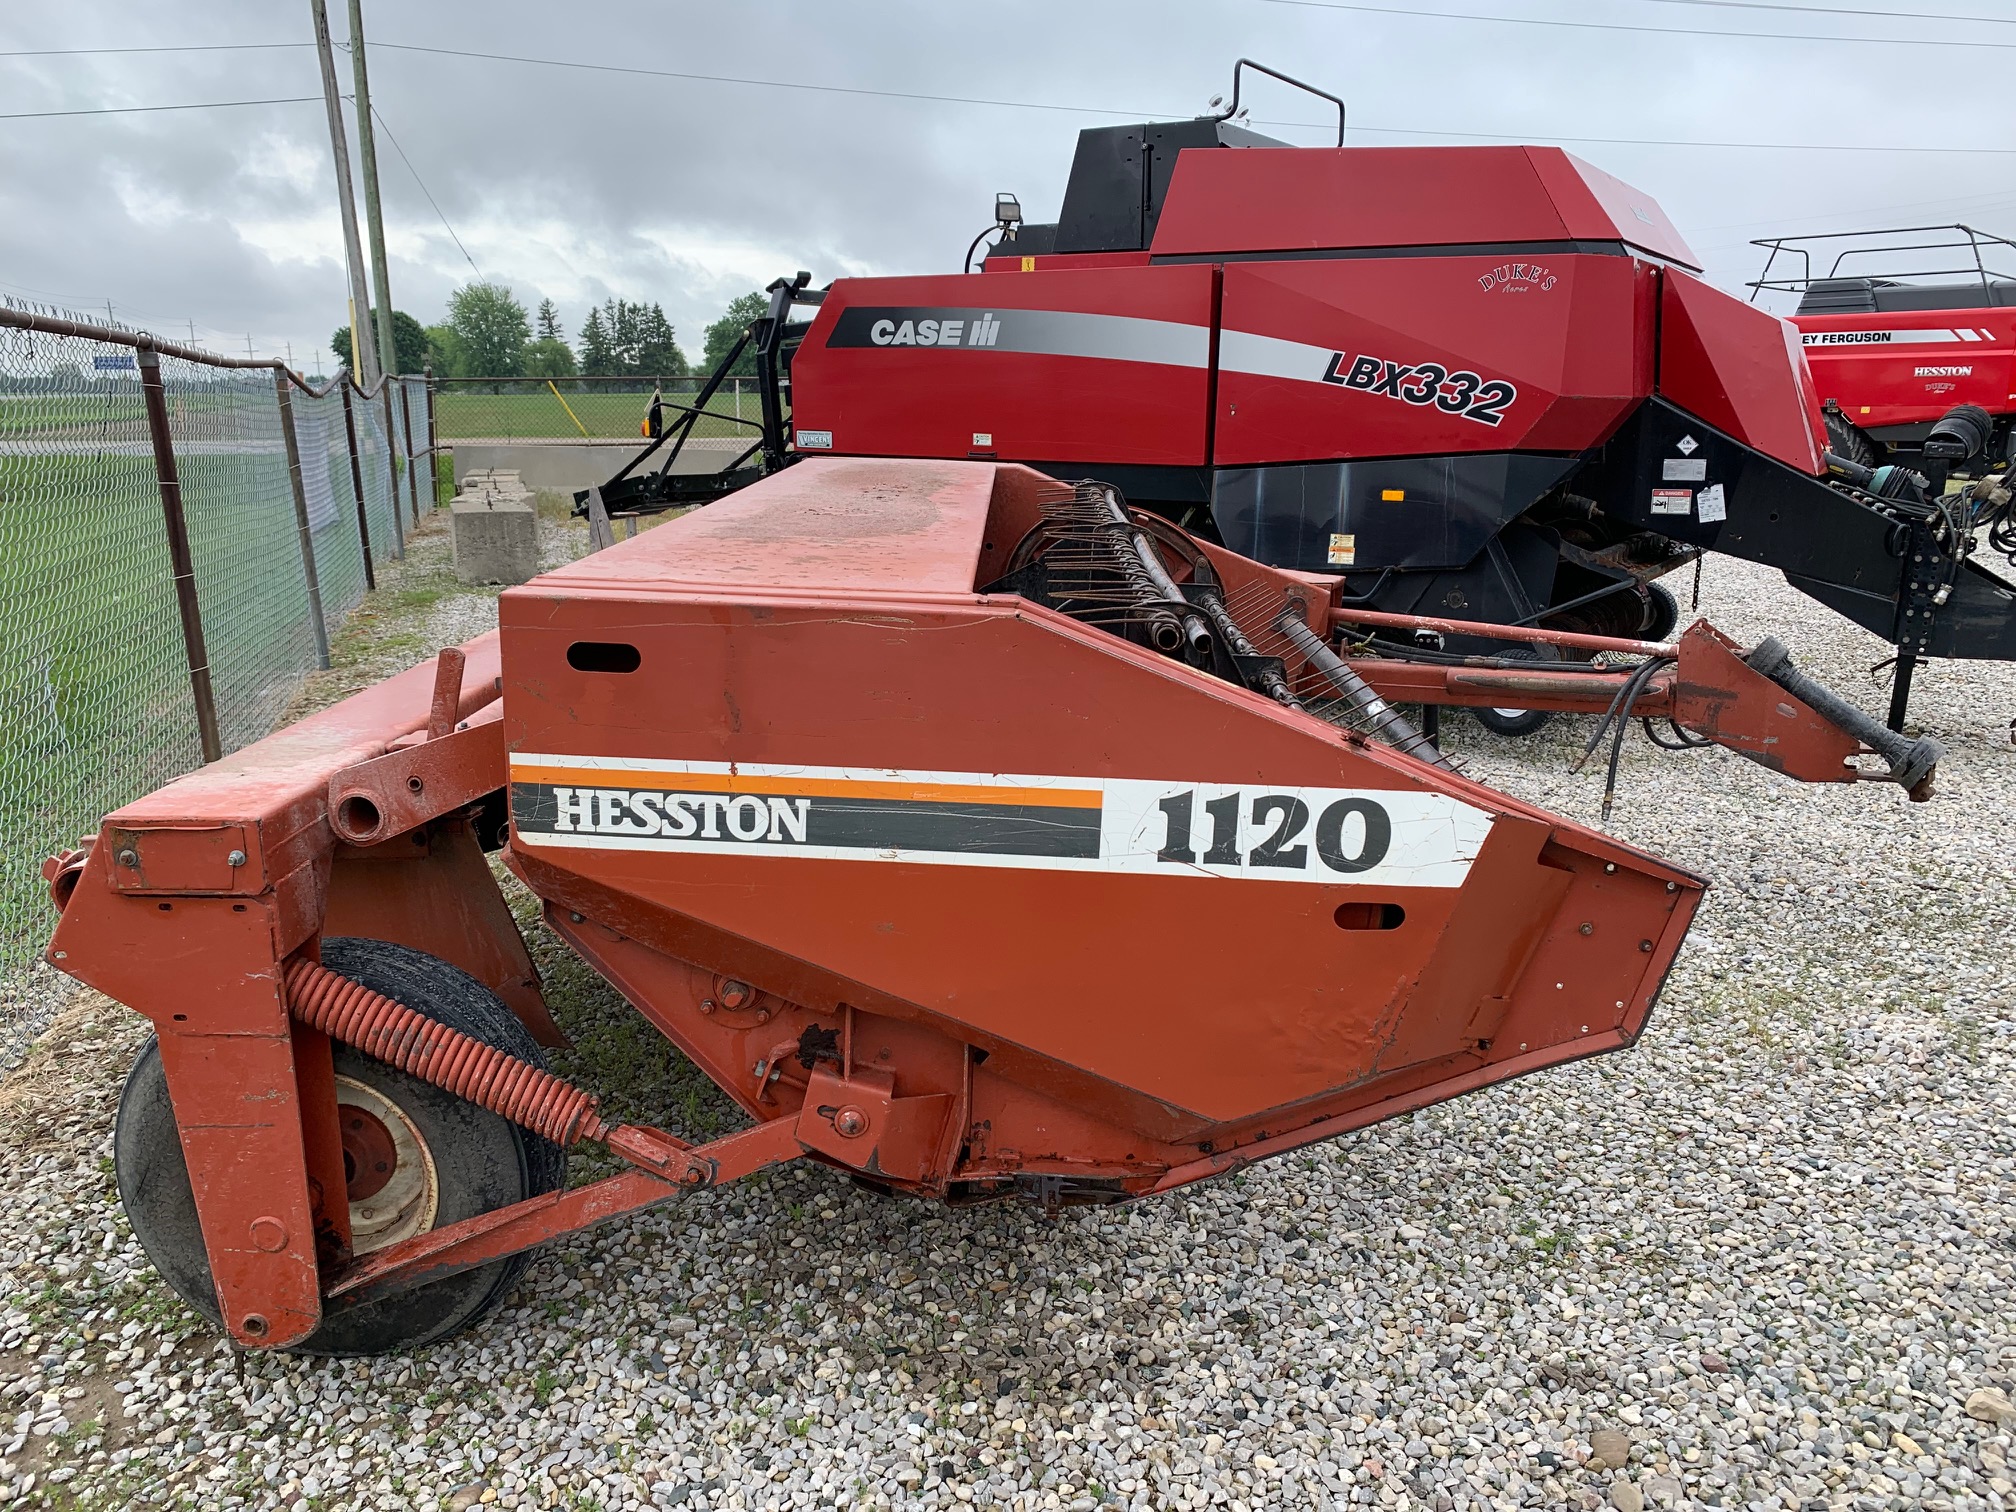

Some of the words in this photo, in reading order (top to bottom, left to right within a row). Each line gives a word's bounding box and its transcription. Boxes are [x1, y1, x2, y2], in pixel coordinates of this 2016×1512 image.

[1478, 263, 1557, 292] DUKE'S
[870, 319, 965, 345] CASE
[1822, 332, 1892, 344] FERGUSON
[1914, 366, 1973, 377] HESSTON
[1321, 350, 1517, 428] LBX332
[803, 435, 830, 443] VINCENT
[553, 788, 811, 842] HESSTON
[1157, 790, 1391, 873] 1120
